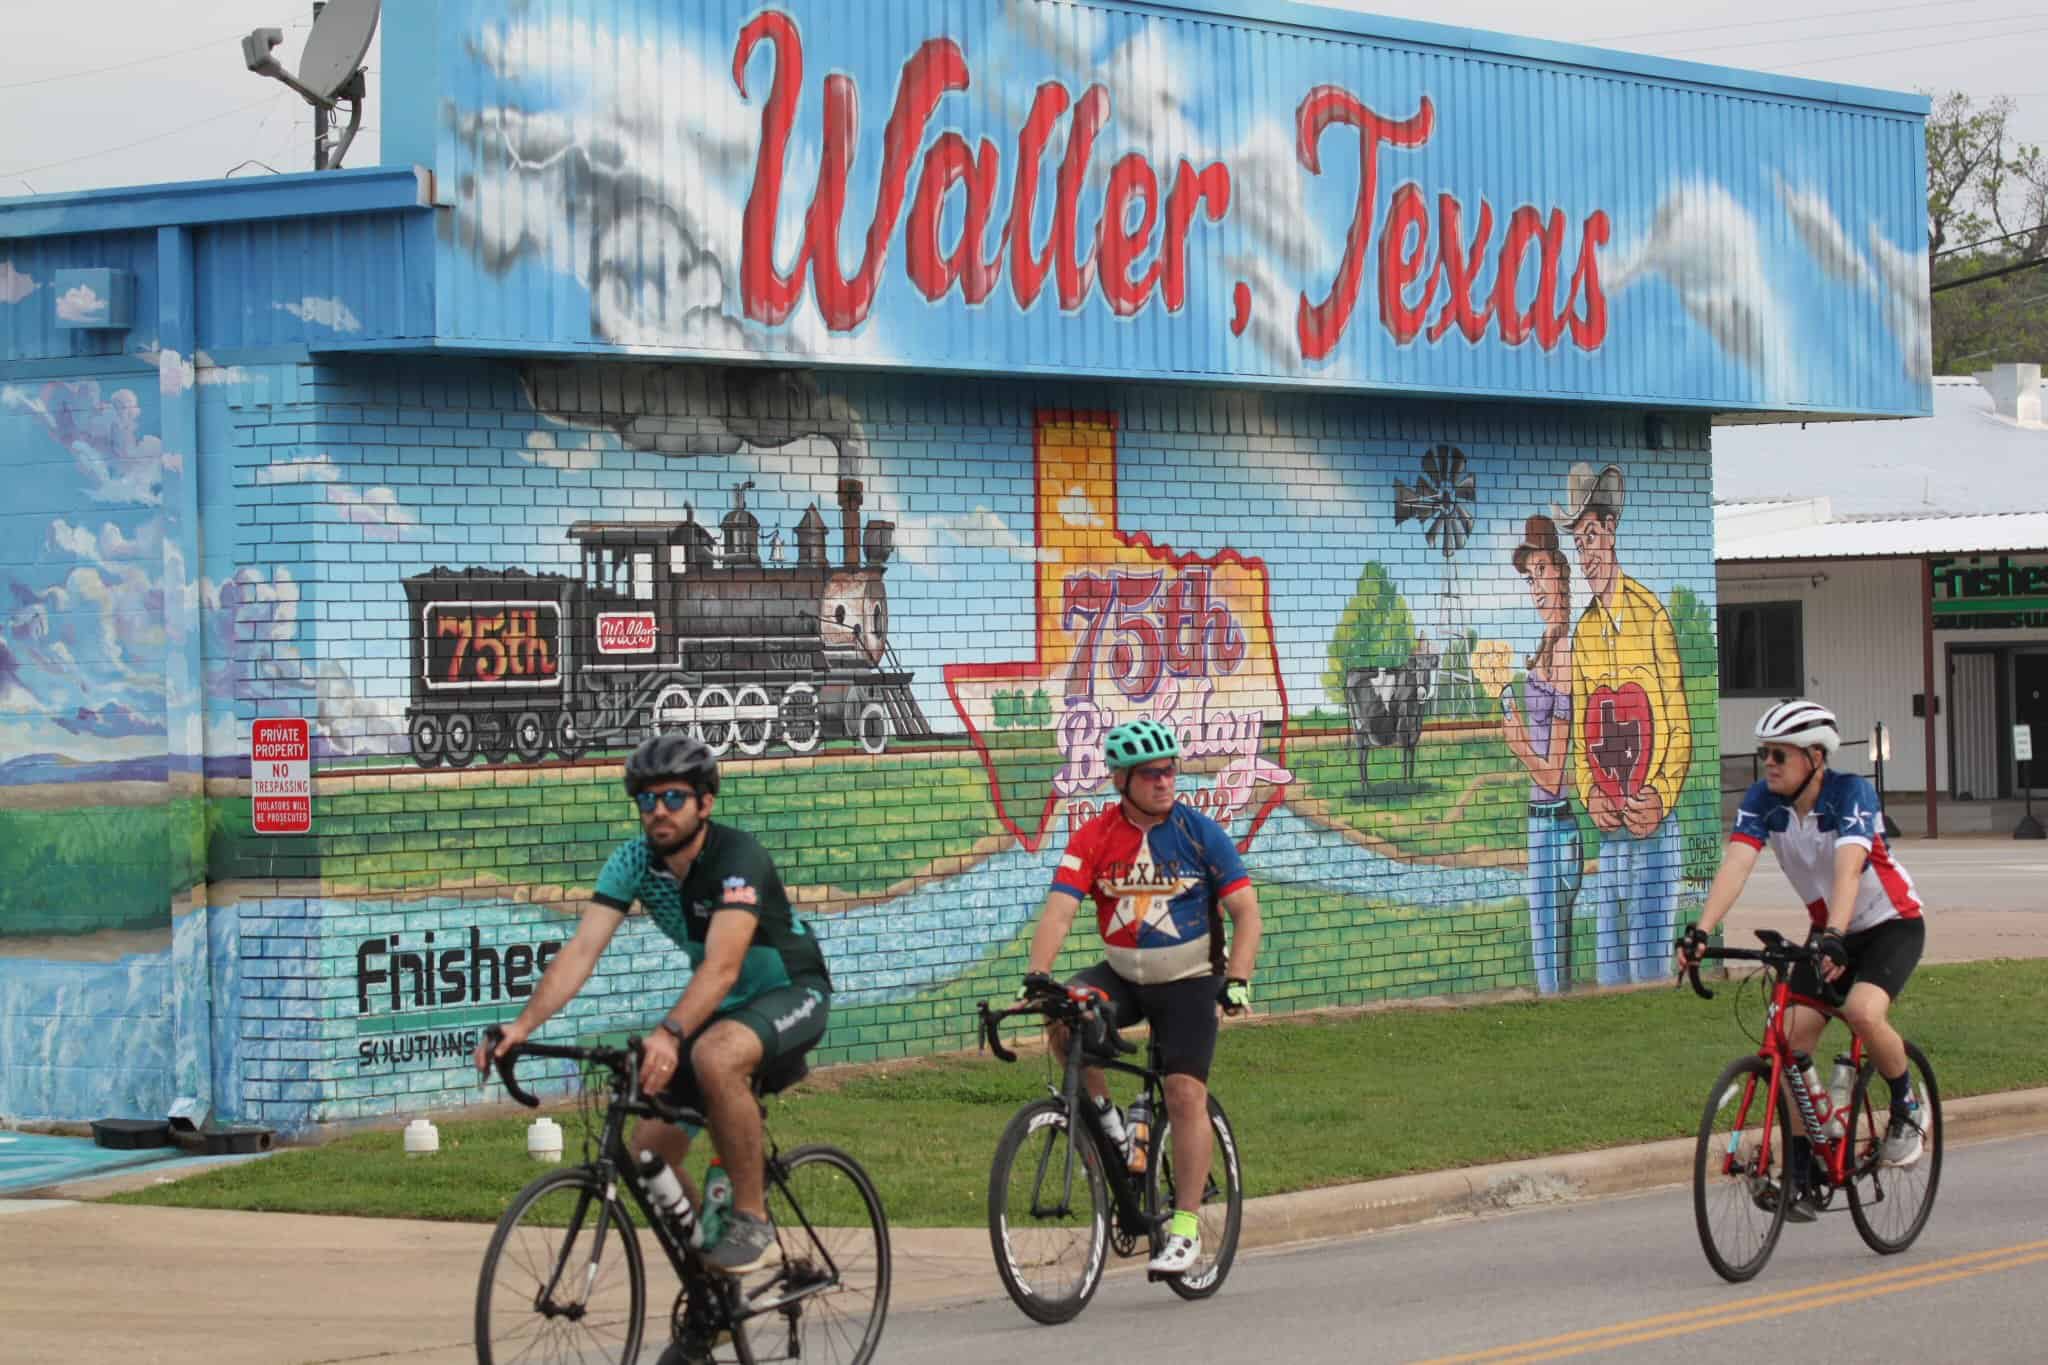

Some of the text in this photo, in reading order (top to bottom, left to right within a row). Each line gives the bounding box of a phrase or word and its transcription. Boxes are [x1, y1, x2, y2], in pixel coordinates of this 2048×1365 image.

[1296, 82, 1610, 361] Texas
[1062, 565, 1246, 705] 75th
[437, 608, 556, 682] 75th
[260, 728, 300, 742] PRIVATE
[1054, 676, 1294, 807] Bihday
[255, 743, 305, 758] PROPERTY
[272, 763, 289, 778] NO
[255, 780, 308, 793] TRESPASSING
[256, 801, 307, 811] VIOLATORS WILL
[256, 812, 308, 823] BE PROSECUTED
[358, 1030, 477, 1067] SOLUTIONS
